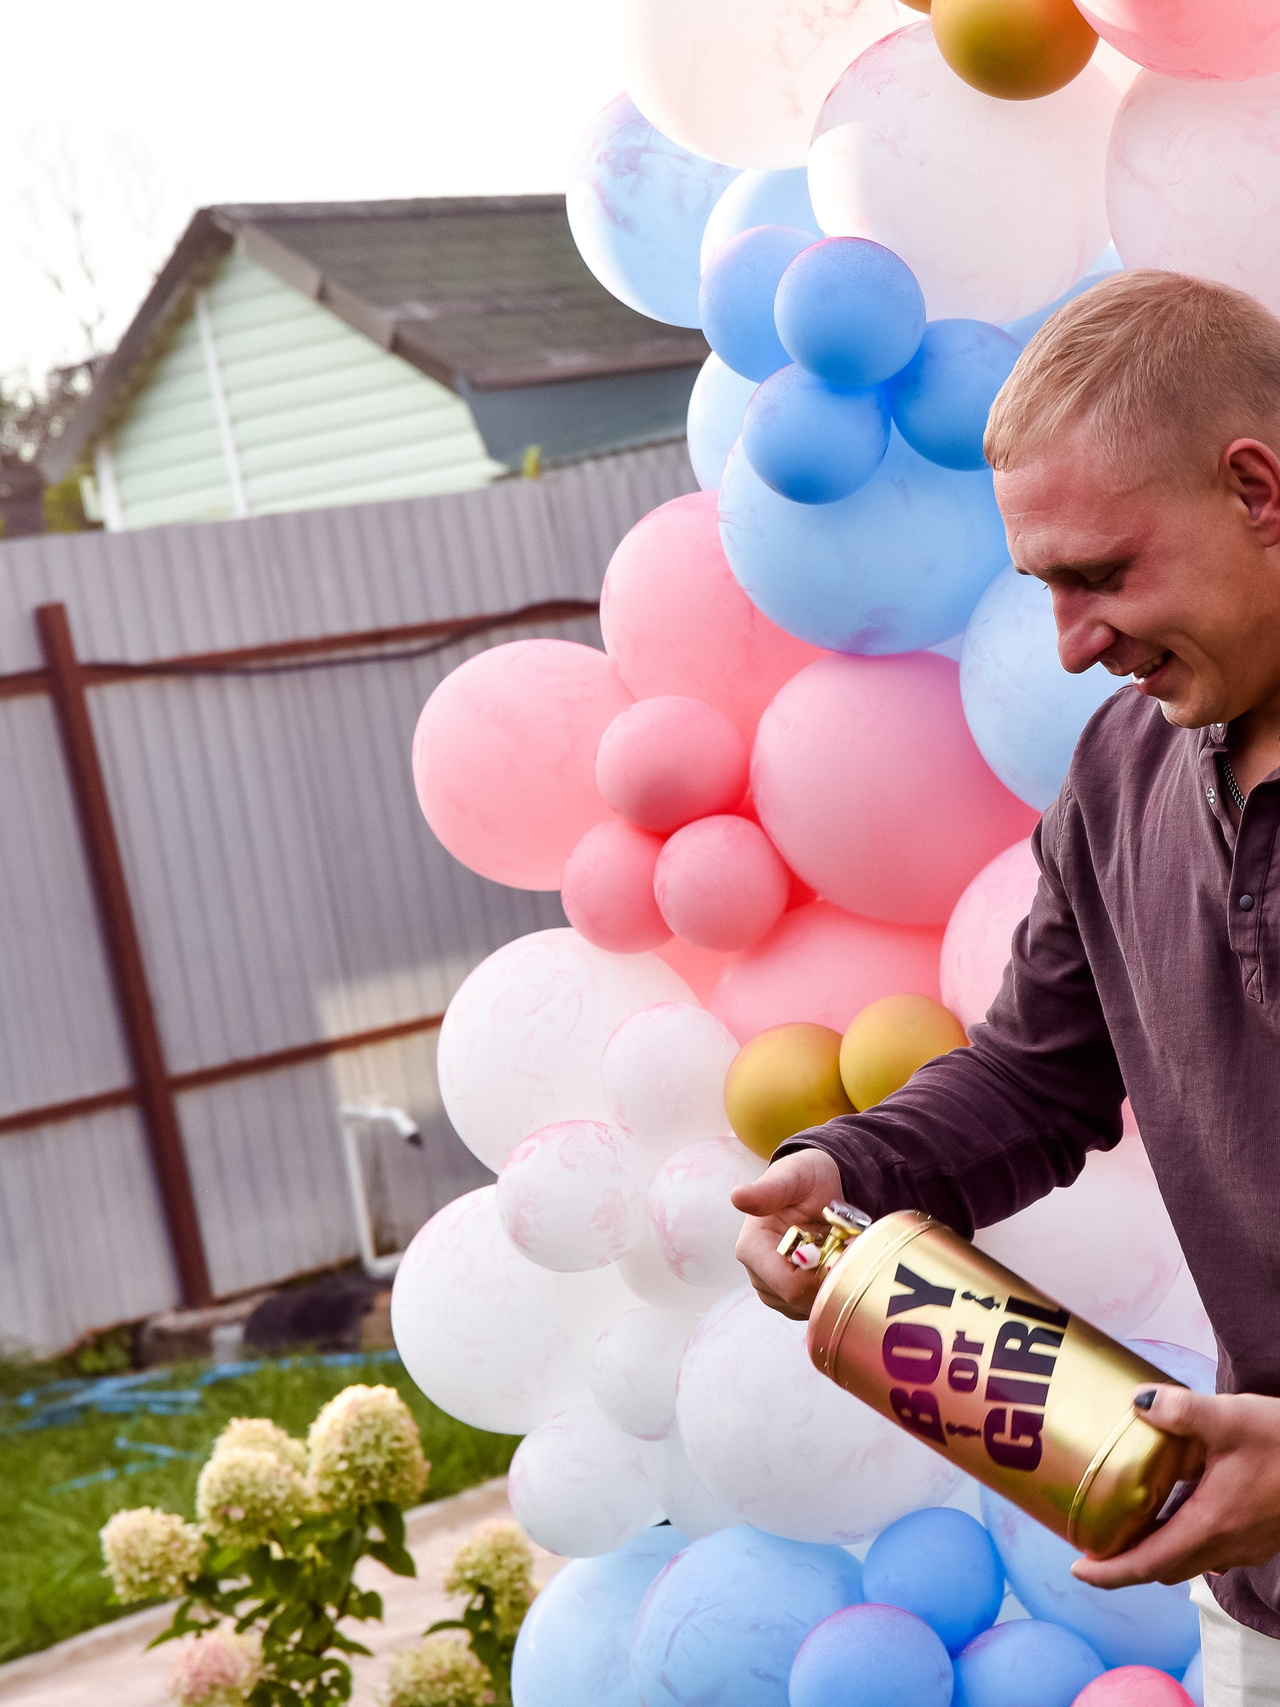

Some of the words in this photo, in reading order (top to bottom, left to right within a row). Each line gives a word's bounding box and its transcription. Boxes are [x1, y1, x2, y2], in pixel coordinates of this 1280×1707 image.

[882, 1262, 957, 1446] BOY
[947, 1329, 985, 1394] or
[983, 1294, 1071, 1472] GIRL
